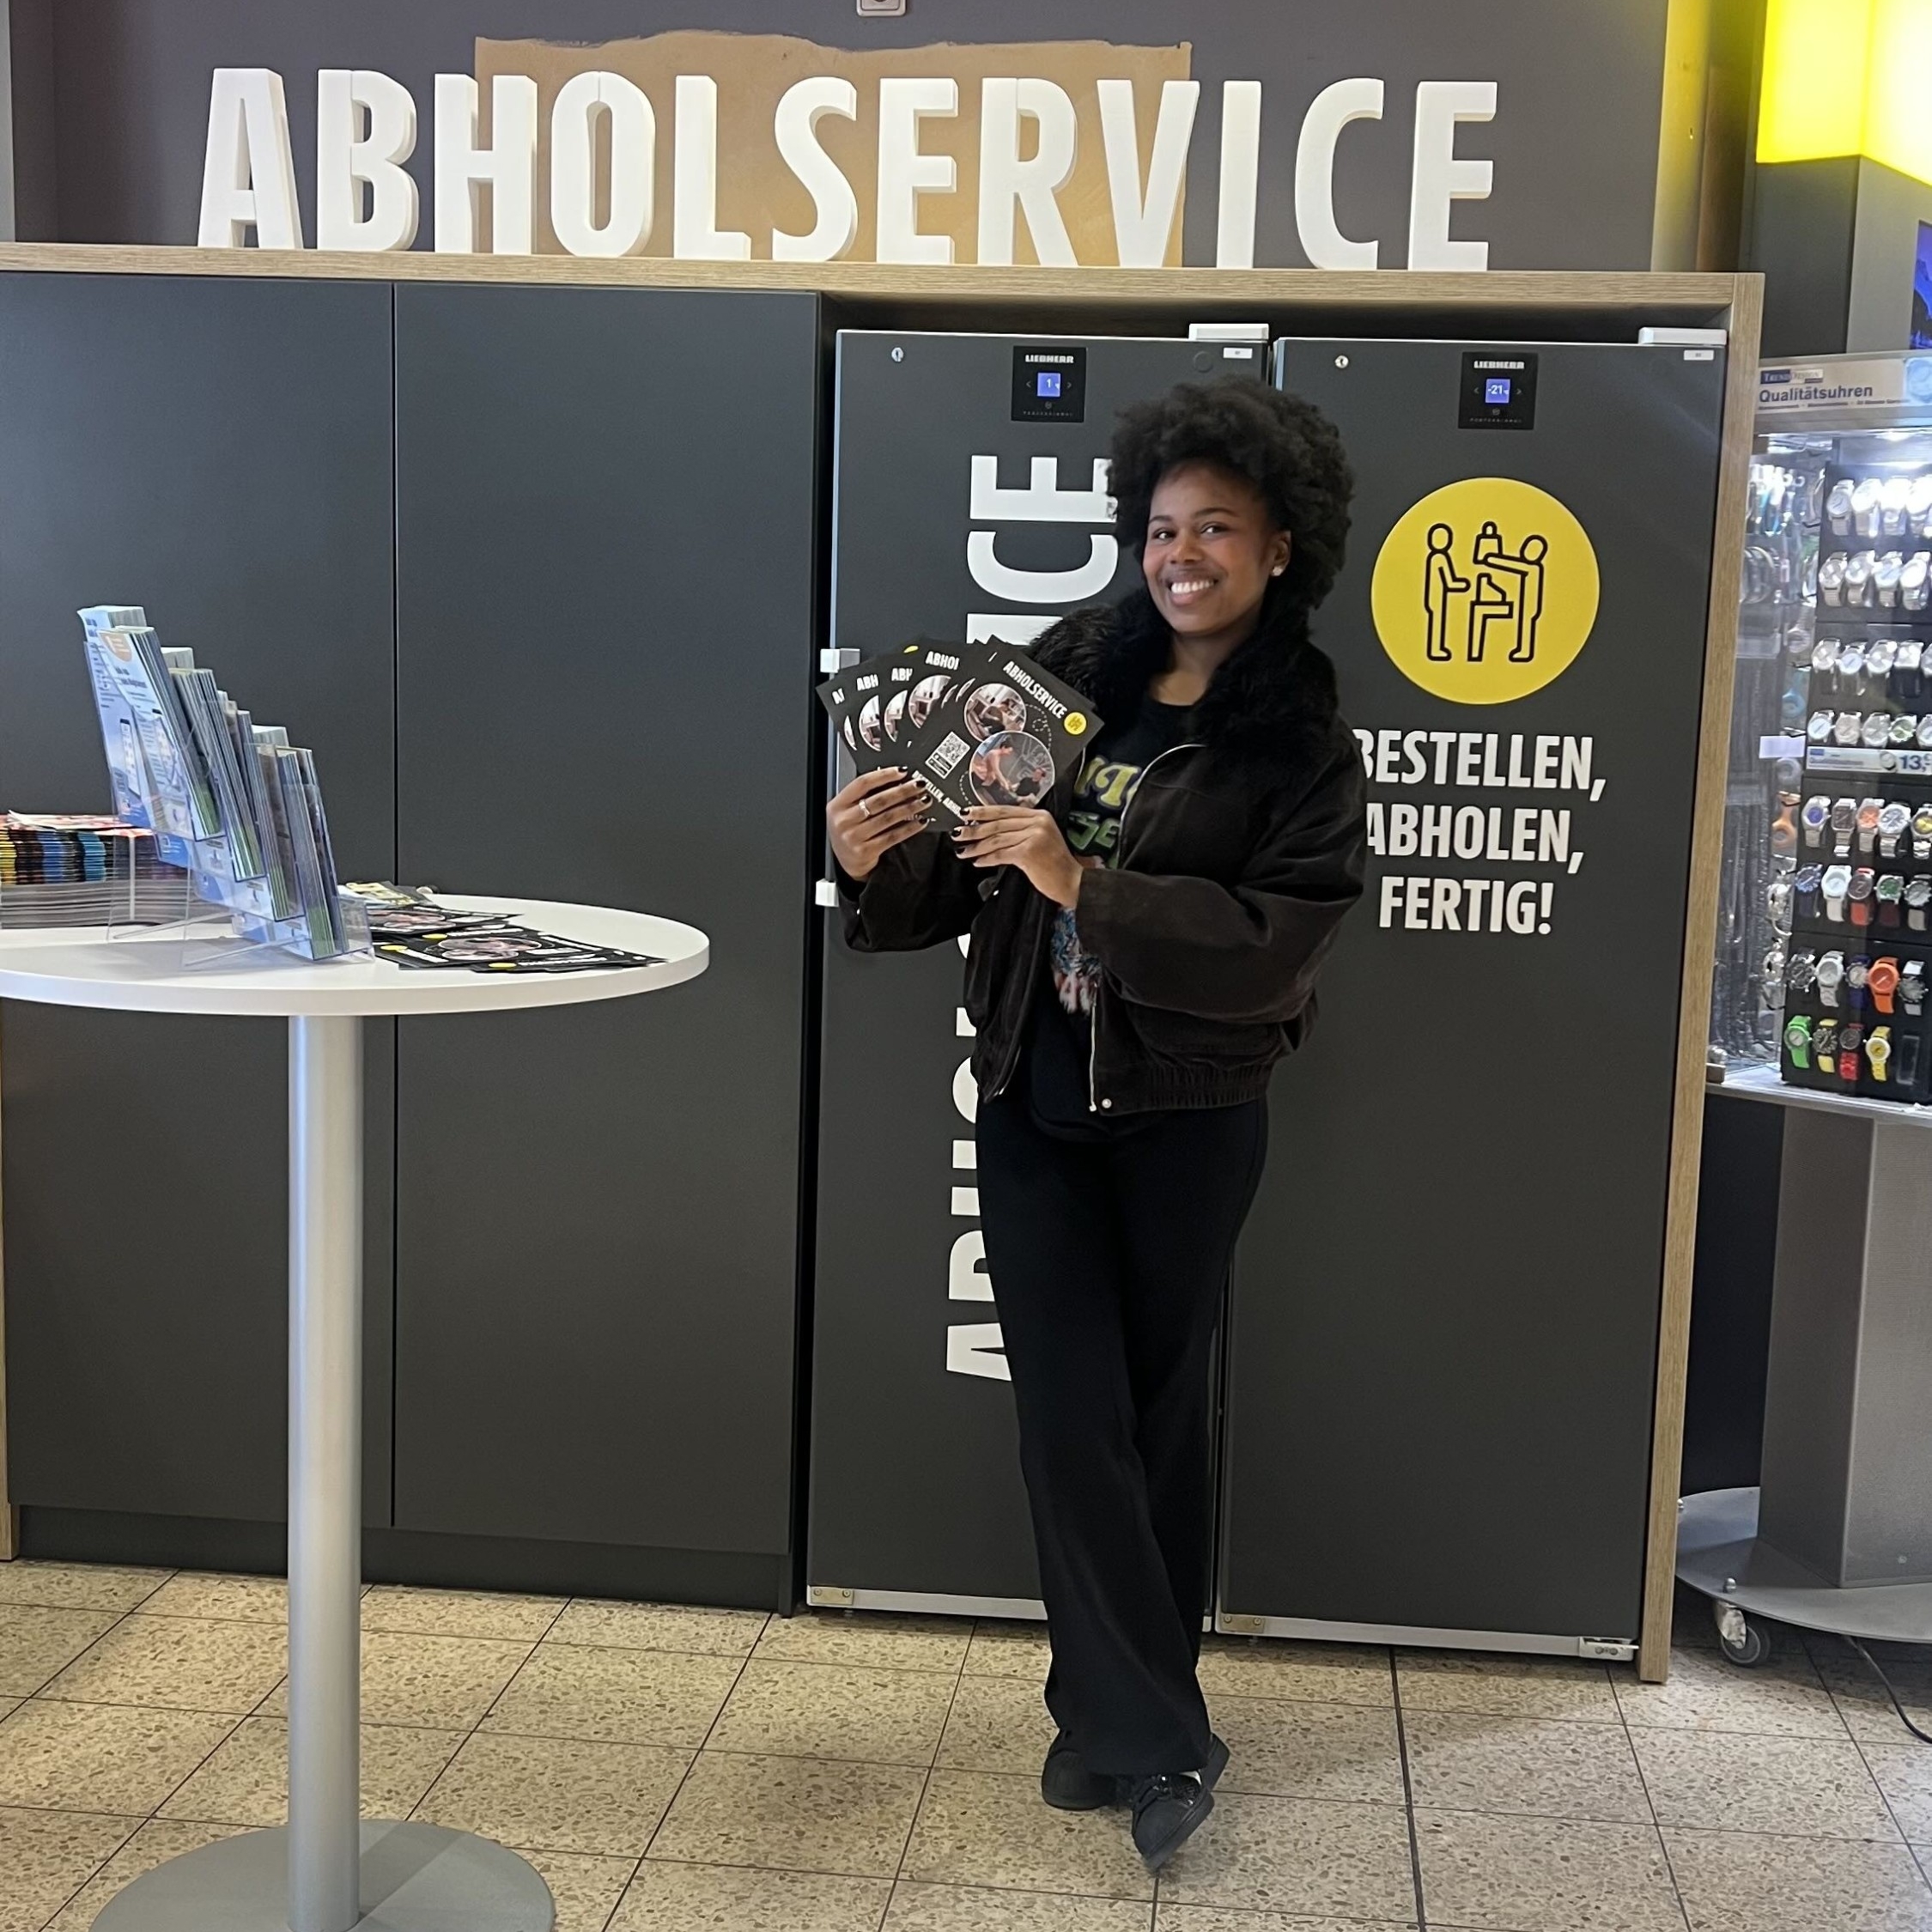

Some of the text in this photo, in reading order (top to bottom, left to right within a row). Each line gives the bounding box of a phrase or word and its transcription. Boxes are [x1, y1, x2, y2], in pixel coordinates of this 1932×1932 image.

[197, 68, 1498, 270] ABHOLSERVICE
[1759, 386, 1873, 403] Qualitätsuhren
[1003, 660, 1067, 719] ABHOLSERVICE
[1366, 803, 1584, 874] ABHOLEN,
[1379, 876, 1553, 935] FERTIG!
